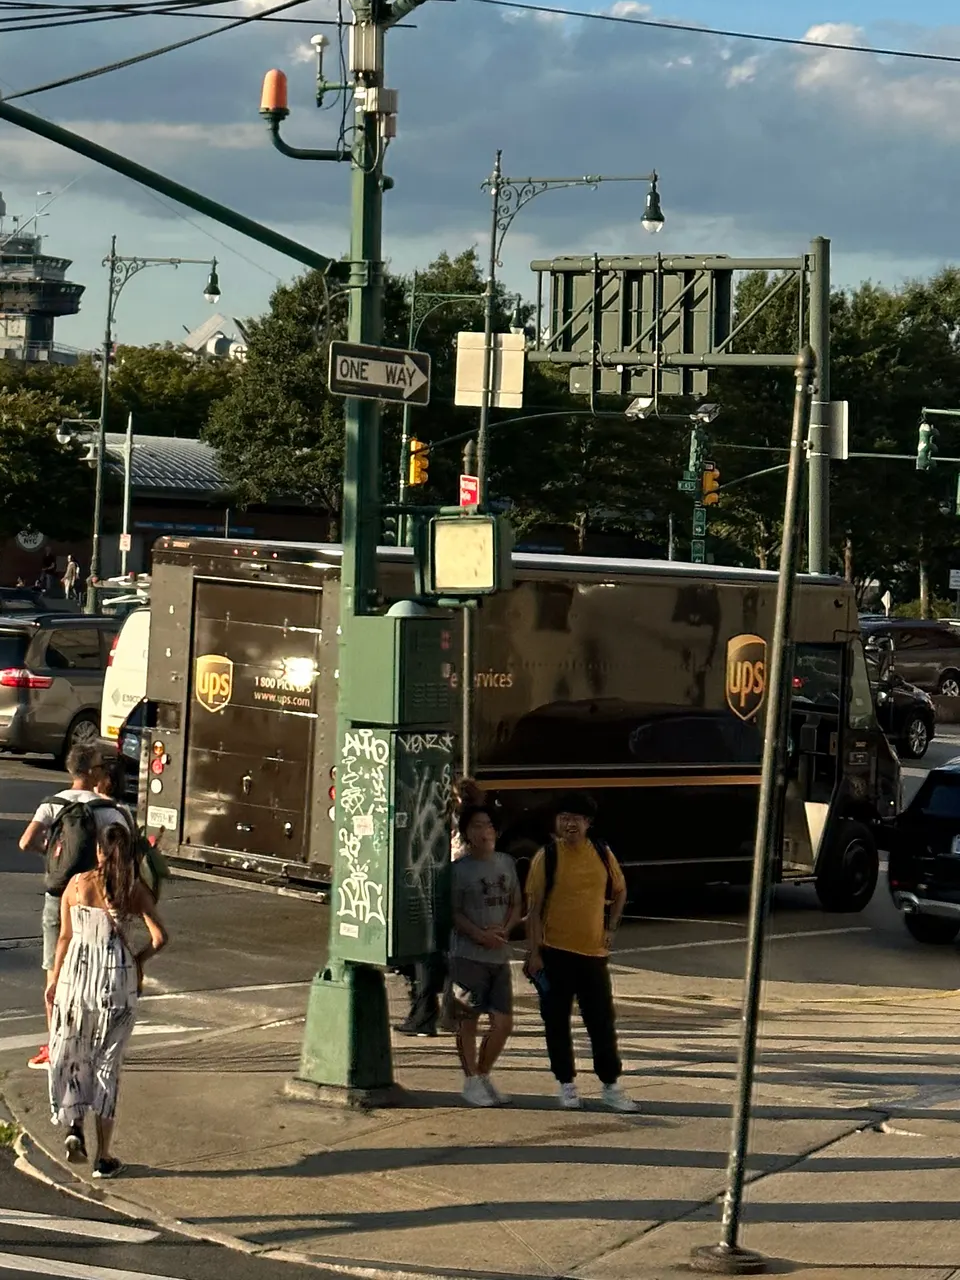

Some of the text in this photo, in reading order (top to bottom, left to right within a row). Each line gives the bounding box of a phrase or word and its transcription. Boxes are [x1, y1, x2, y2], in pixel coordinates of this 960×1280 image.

[340, 358, 416, 387] ONE WAY
[200, 672, 230, 704] ups
[260, 677, 276, 689] 800
[729, 661, 764, 707] ups
[254, 691, 310, 708] www.ups.com
